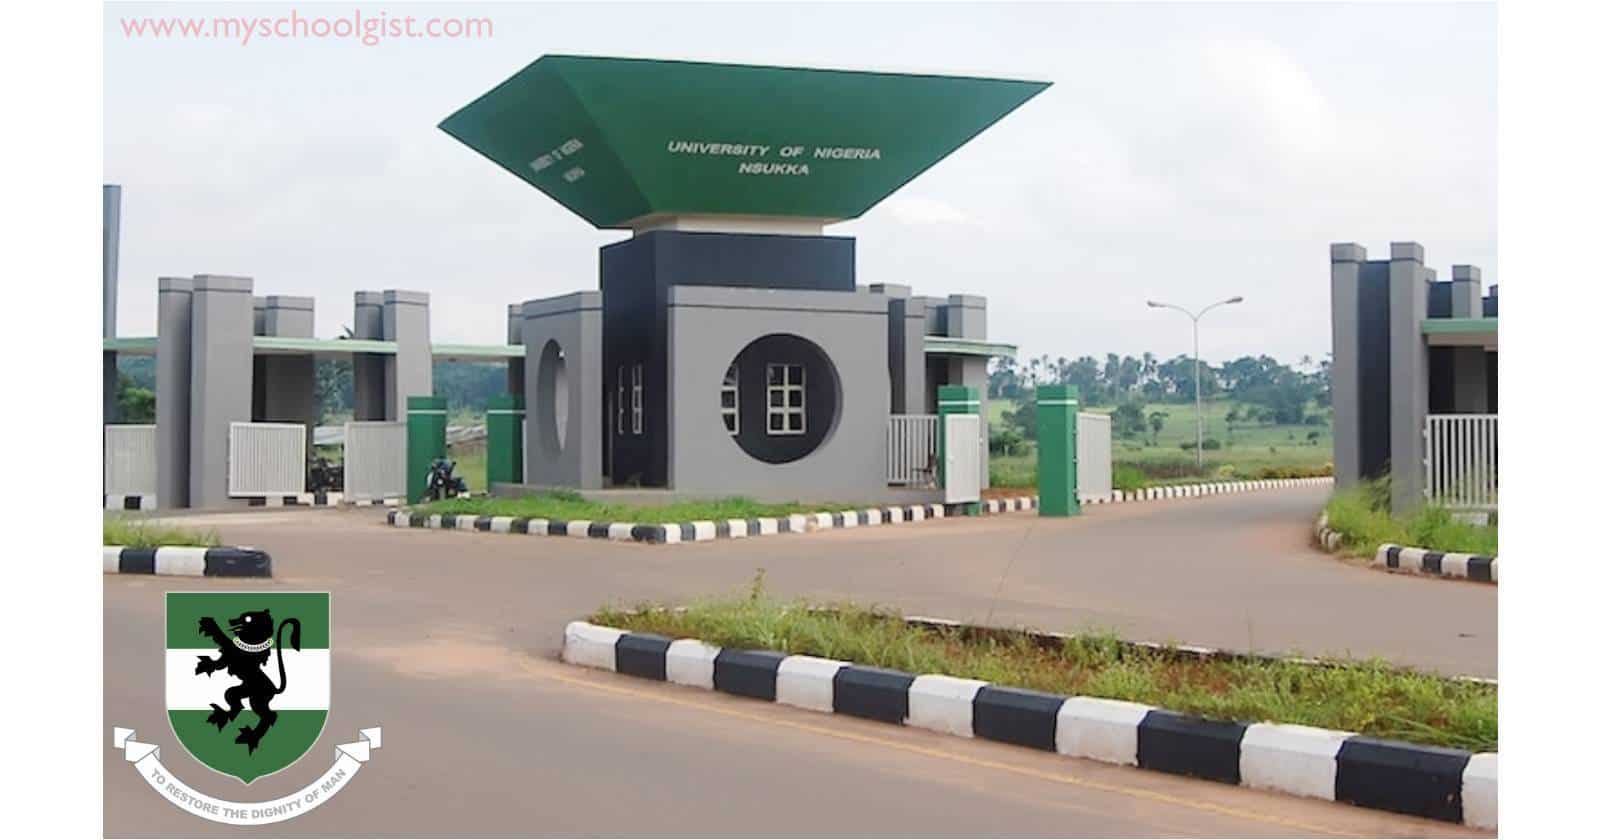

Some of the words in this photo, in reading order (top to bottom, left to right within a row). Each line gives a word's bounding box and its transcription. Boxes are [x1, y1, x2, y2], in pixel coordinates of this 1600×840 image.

[668, 140, 770, 157] UNIVERSITY
[779, 146, 805, 158] OF
[813, 147, 881, 160] NIGERIA
[738, 162, 810, 176] NSUKKA
